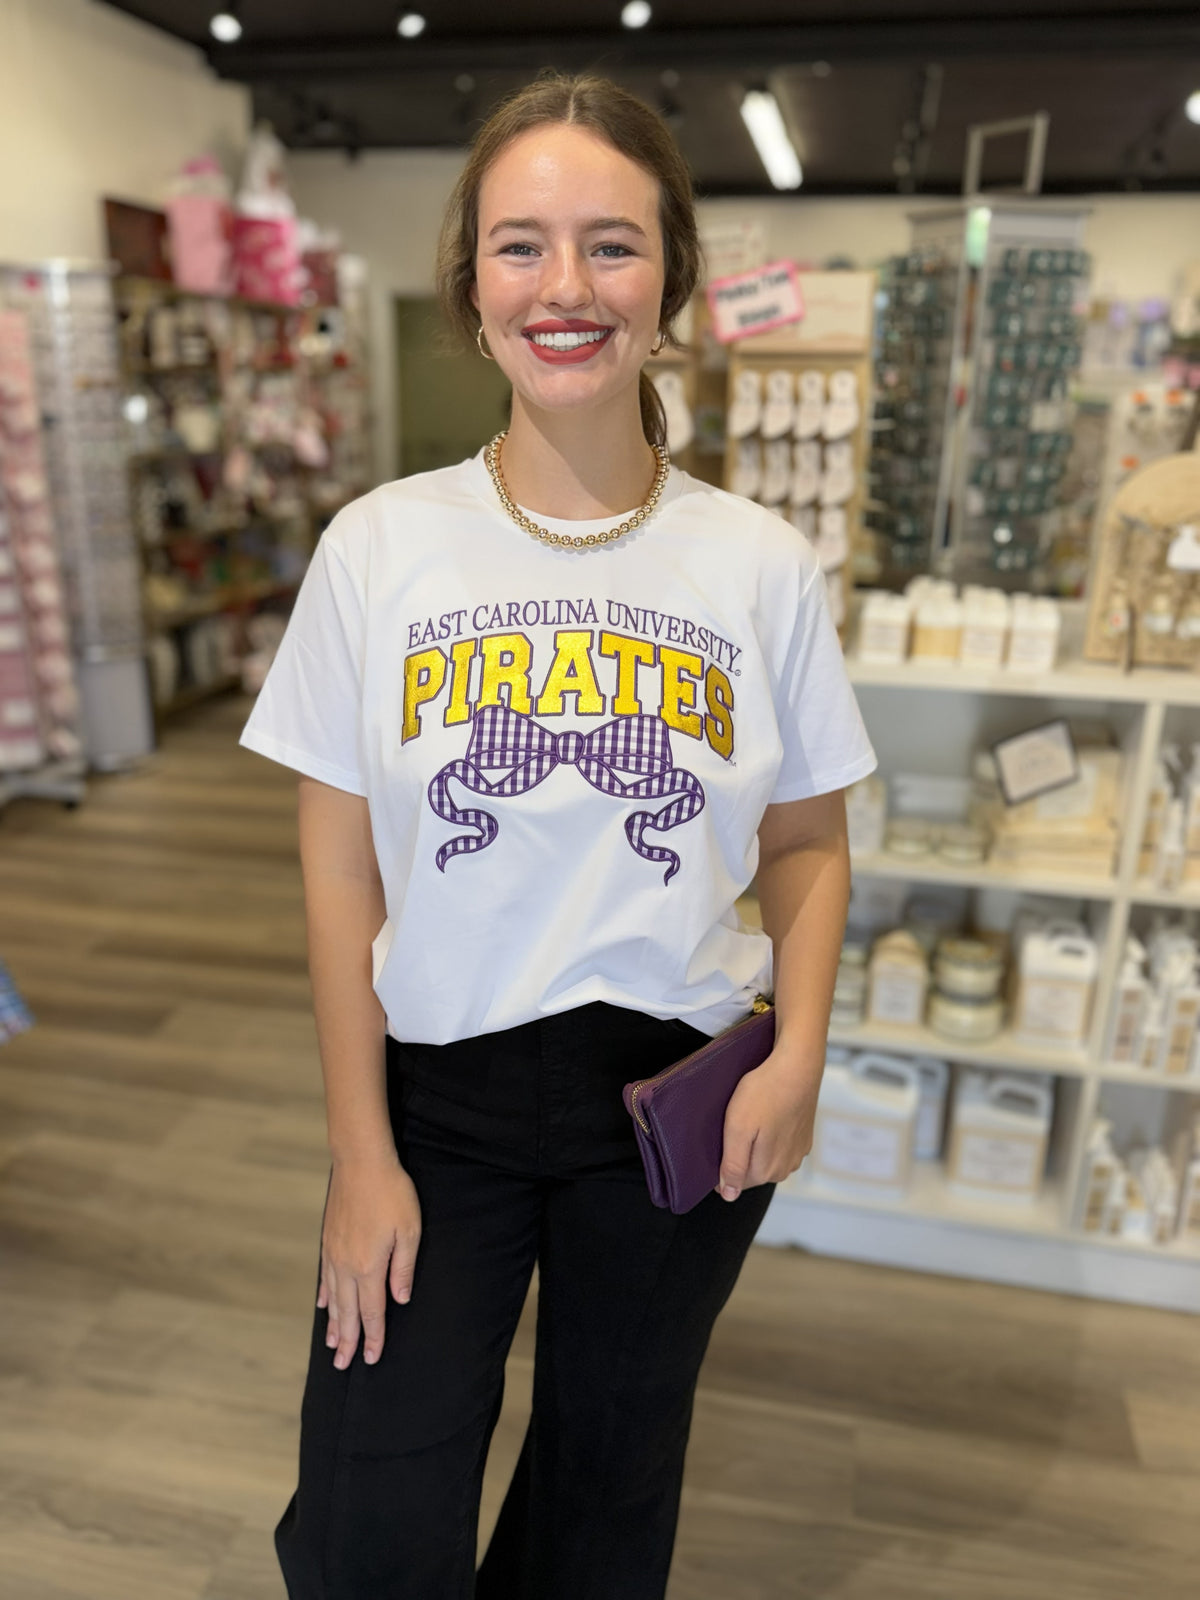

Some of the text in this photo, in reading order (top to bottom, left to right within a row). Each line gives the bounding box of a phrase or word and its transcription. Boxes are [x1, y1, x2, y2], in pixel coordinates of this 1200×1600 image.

[406, 598, 742, 673] EAST CAROLINA UNIVERSITY
[401, 629, 734, 761] PIRATES
